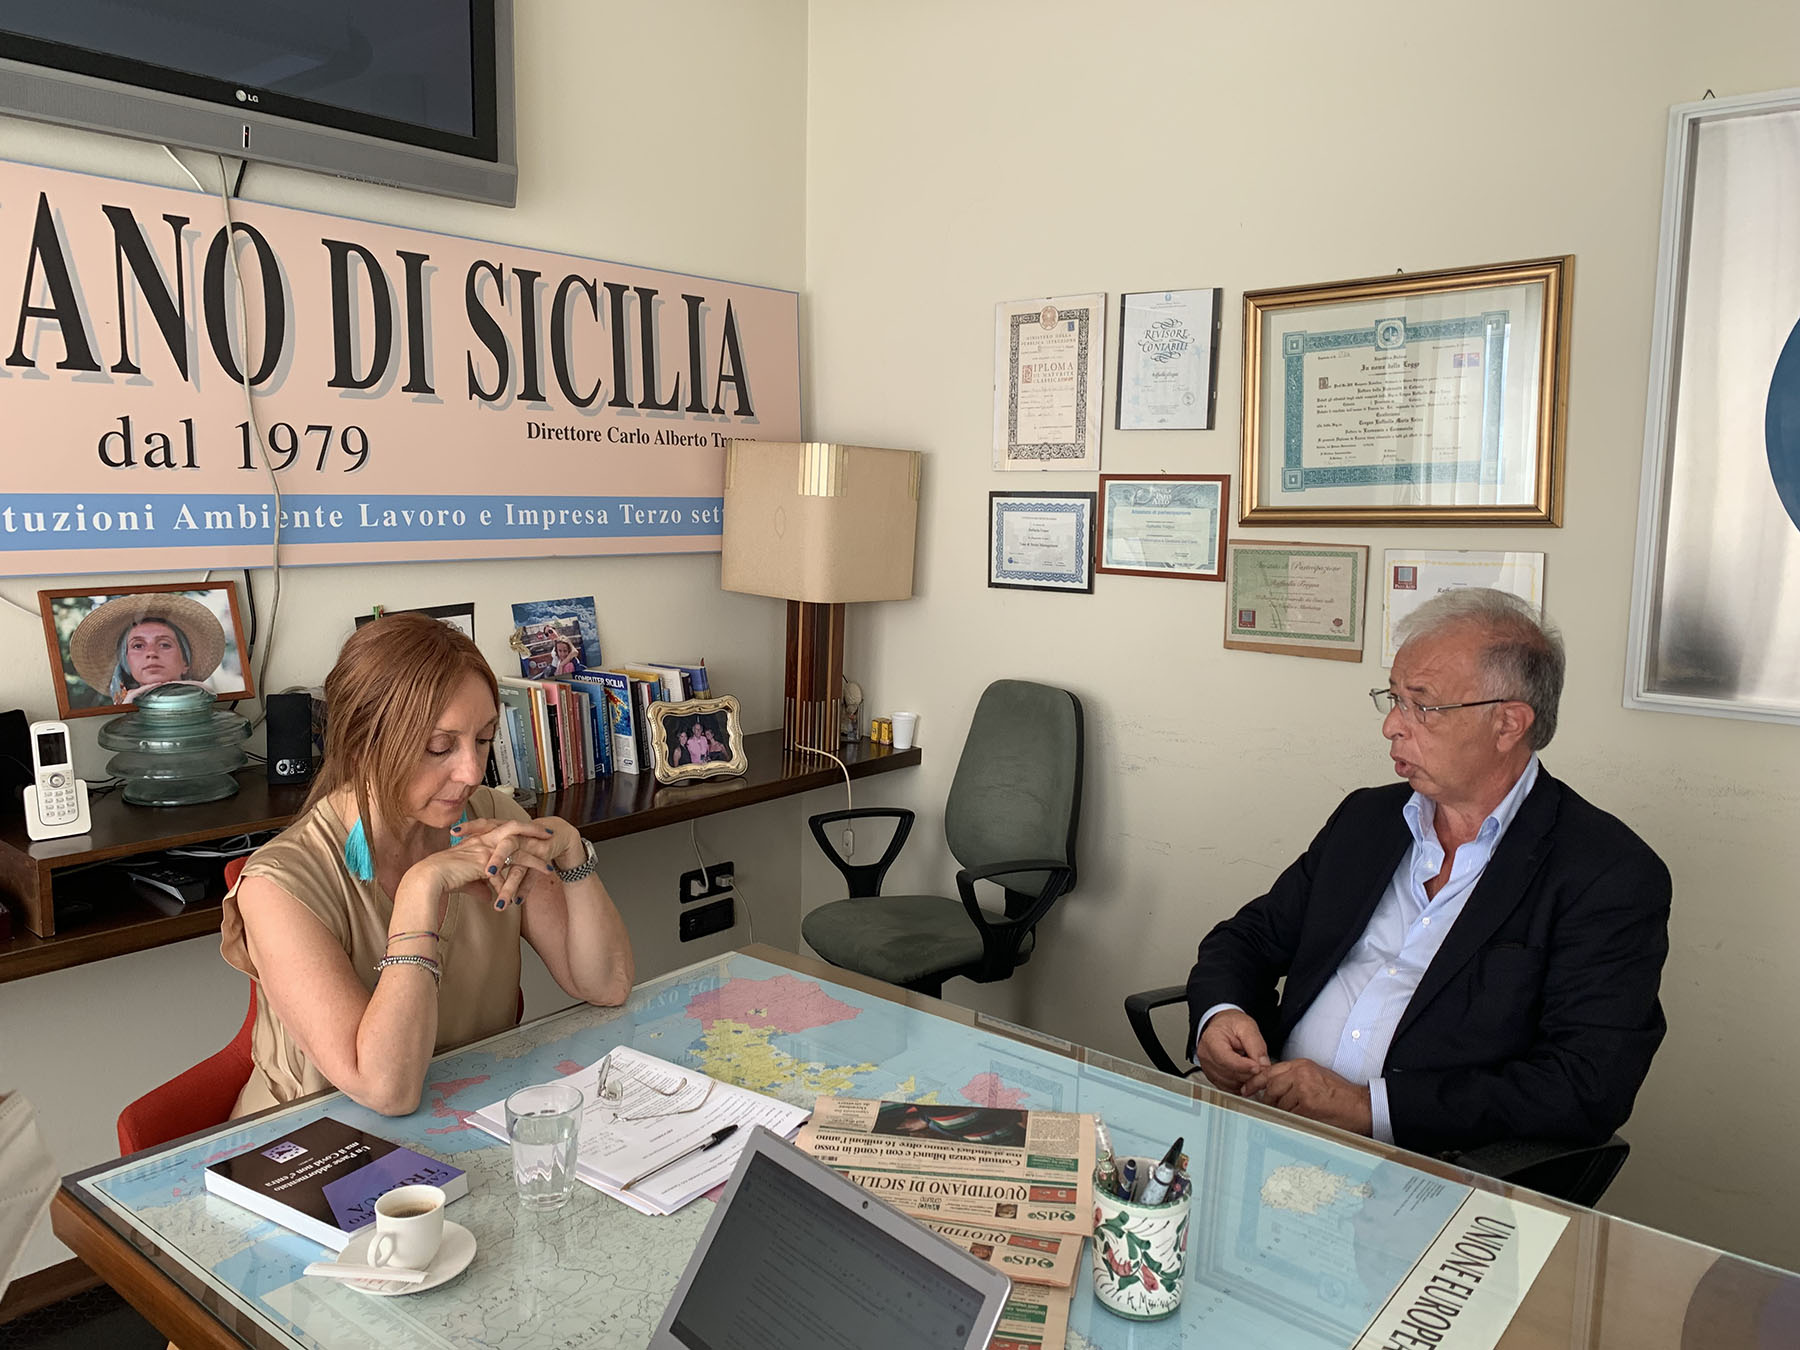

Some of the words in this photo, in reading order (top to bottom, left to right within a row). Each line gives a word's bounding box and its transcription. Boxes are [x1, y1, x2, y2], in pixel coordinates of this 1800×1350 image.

[248, 94, 258, 103] LG
[320, 238, 437, 396] DI
[464, 259, 757, 420] SICILIA
[527, 421, 602, 442] Direttore
[607, 426, 650, 445] Carlo
[654, 429, 708, 448] Alberto
[98, 416, 201, 470] dal
[235, 421, 370, 473] 1979
[2, 504, 156, 532] tuzioni
[173, 504, 344, 530] Ambiente
[359, 504, 466, 529] Lavoro
[479, 511, 492, 529] e
[505, 504, 609, 530] Impresa
[619, 504, 682, 525] Terzo
[691, 506, 725, 524] set
[605, 677, 624, 689] SICILIA
[813, 1143, 840, 1152] rosso
[848, 1137, 883, 1148] milioni
[884, 1140, 897, 1149] 16
[841, 1145, 852, 1155] in
[853, 1146, 879, 1157] conti
[887, 1148, 904, 1157] con
[913, 1150, 947, 1163] bilanci
[313, 1149, 340, 1167] Covid
[332, 1148, 358, 1166] Paese
[949, 1153, 976, 1162] senza
[977, 1156, 1021, 1167] Comuni
[295, 1162, 314, 1175] non
[273, 1160, 334, 1193] addormentato
[851, 1174, 905, 1191] SICILIA
[909, 1179, 925, 1192] DI
[929, 1180, 1028, 1202] QUOTIDIANO
[1440, 1216, 1516, 1282] UNIONE
